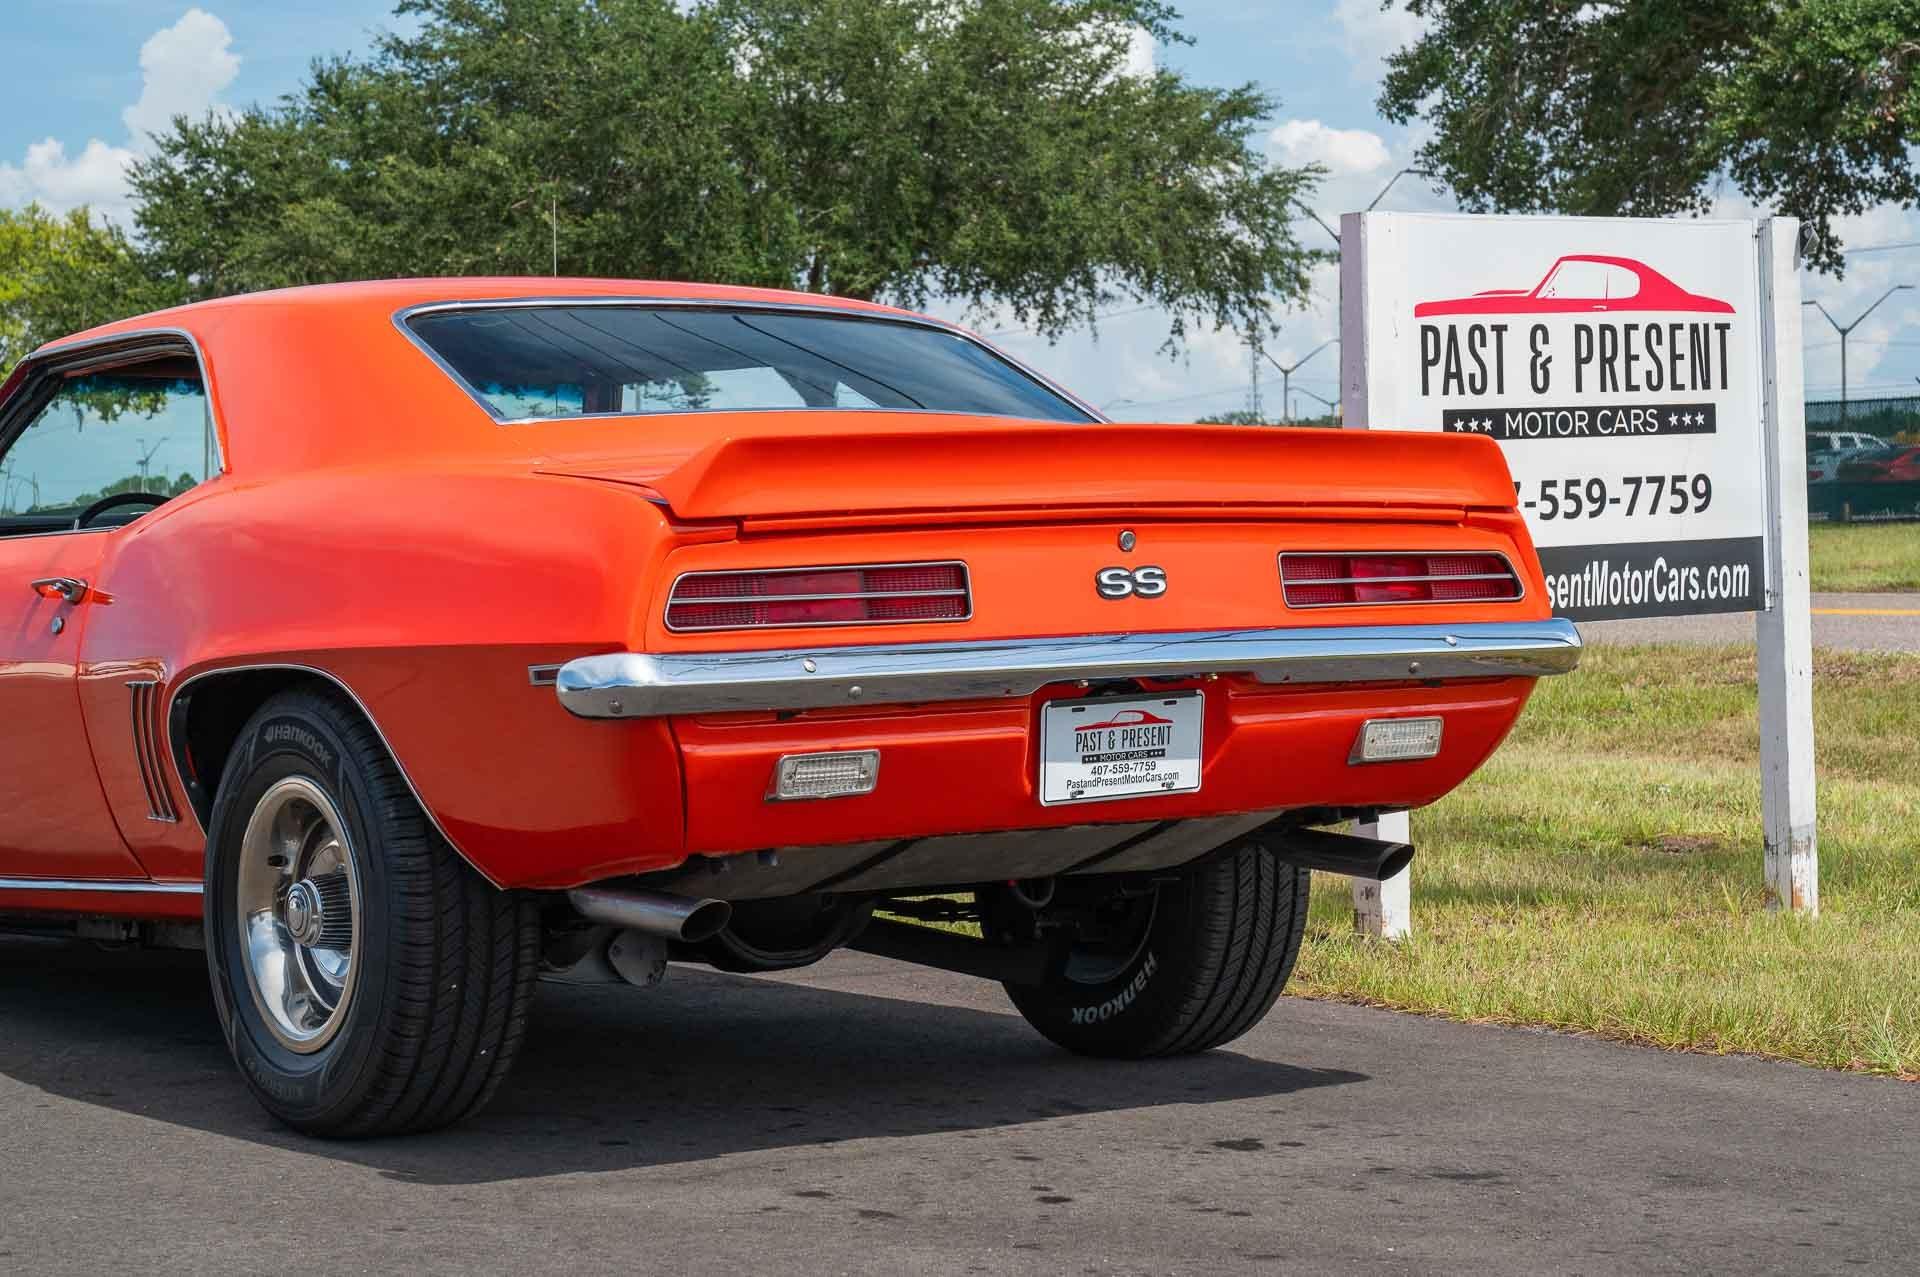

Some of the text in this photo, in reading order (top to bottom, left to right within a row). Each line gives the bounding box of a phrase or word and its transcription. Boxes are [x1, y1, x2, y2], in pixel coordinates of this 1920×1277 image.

[1420, 322, 1732, 396] PAST & PRESENT
[1504, 408, 1659, 437] MOTOR CARS
[1095, 566, 1167, 599] SS
[1075, 725, 1173, 752] PAST & PRESENT
[1091, 760, 1157, 776] 407-559-7759
[1099, 750, 1148, 763] MOTOR CARS
[1066, 770, 1179, 790] PastandPresentMotorCars.com
